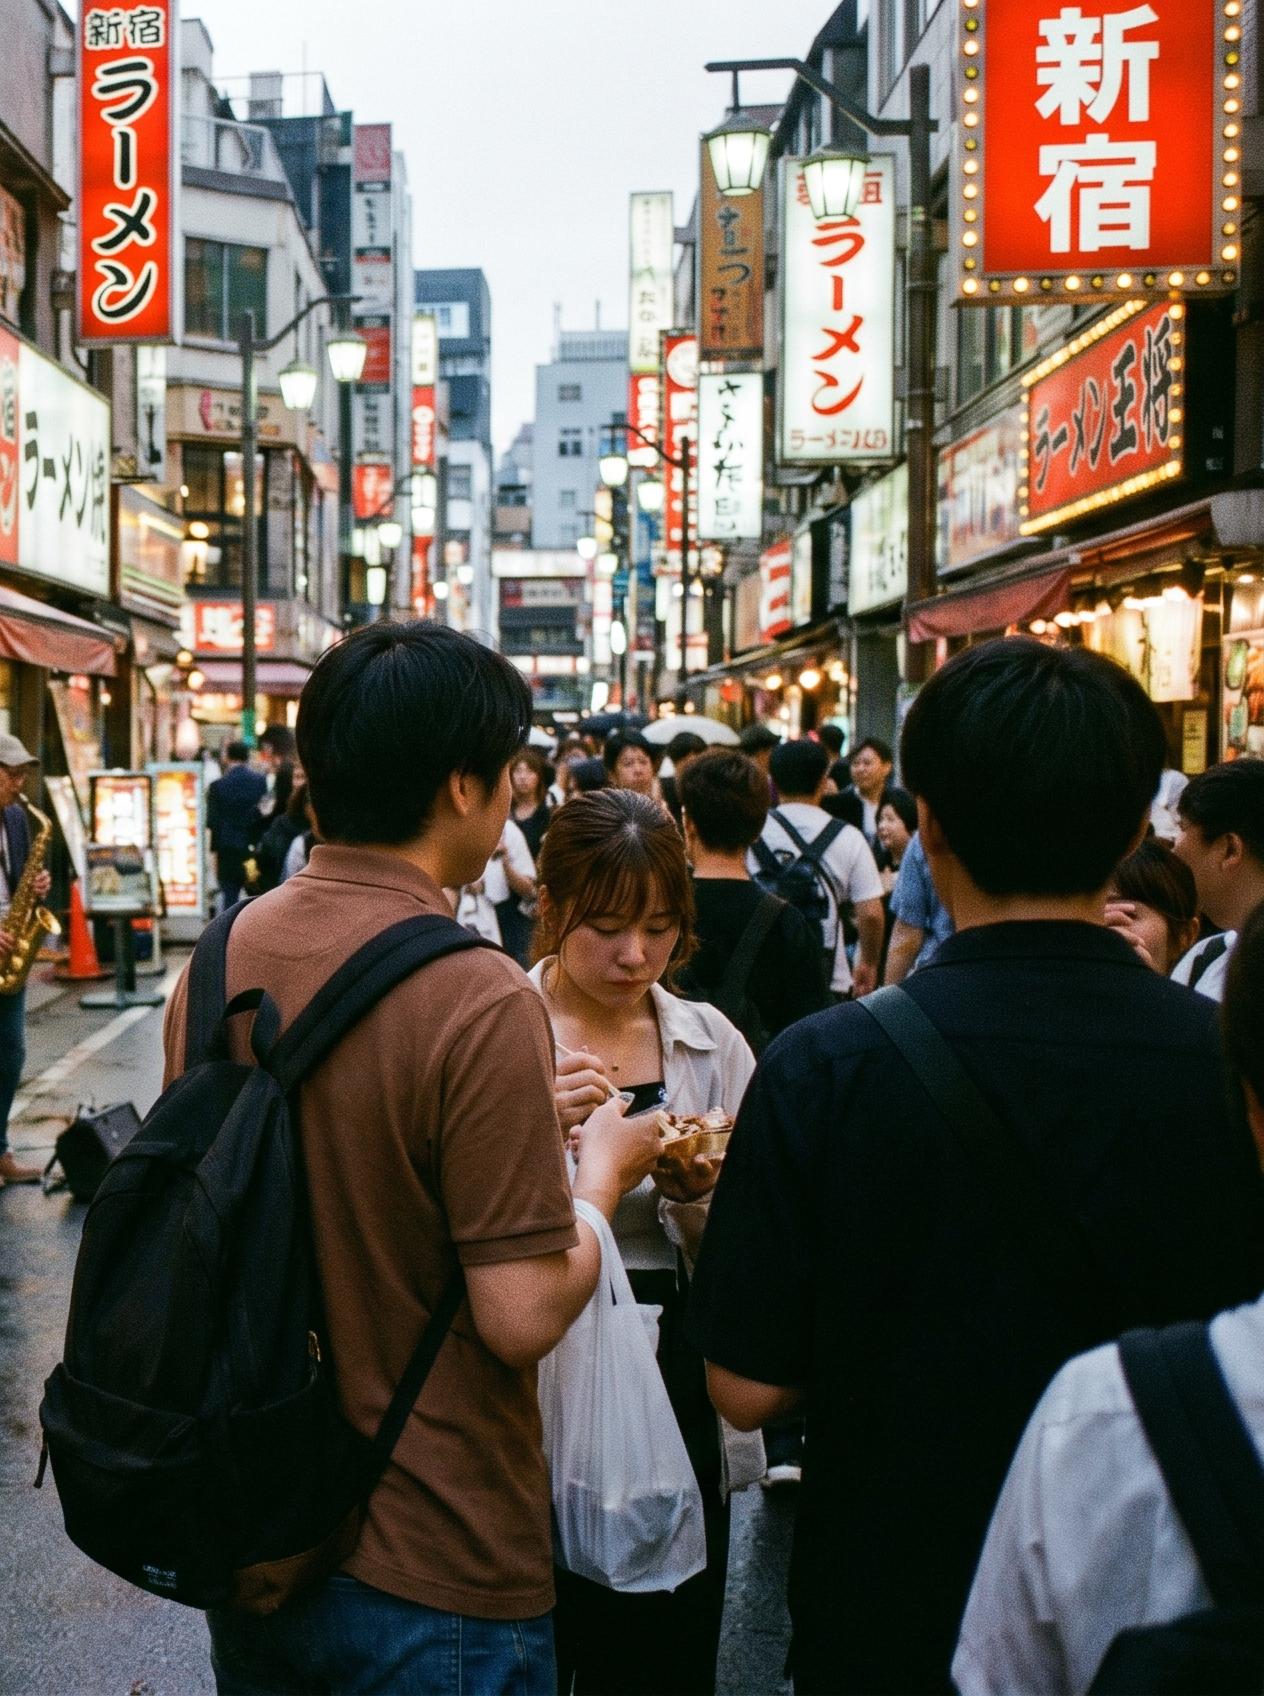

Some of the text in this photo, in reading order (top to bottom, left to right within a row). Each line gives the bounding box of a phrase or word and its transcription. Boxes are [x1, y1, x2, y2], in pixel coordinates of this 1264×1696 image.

[87, 9, 163, 48] 新宿
[1034, 4, 1159, 253] 新宿
[93, 58, 157, 322] ラーメン
[811, 216, 864, 416] ラーメン
[1035, 314, 1172, 494] ラーメン王将
